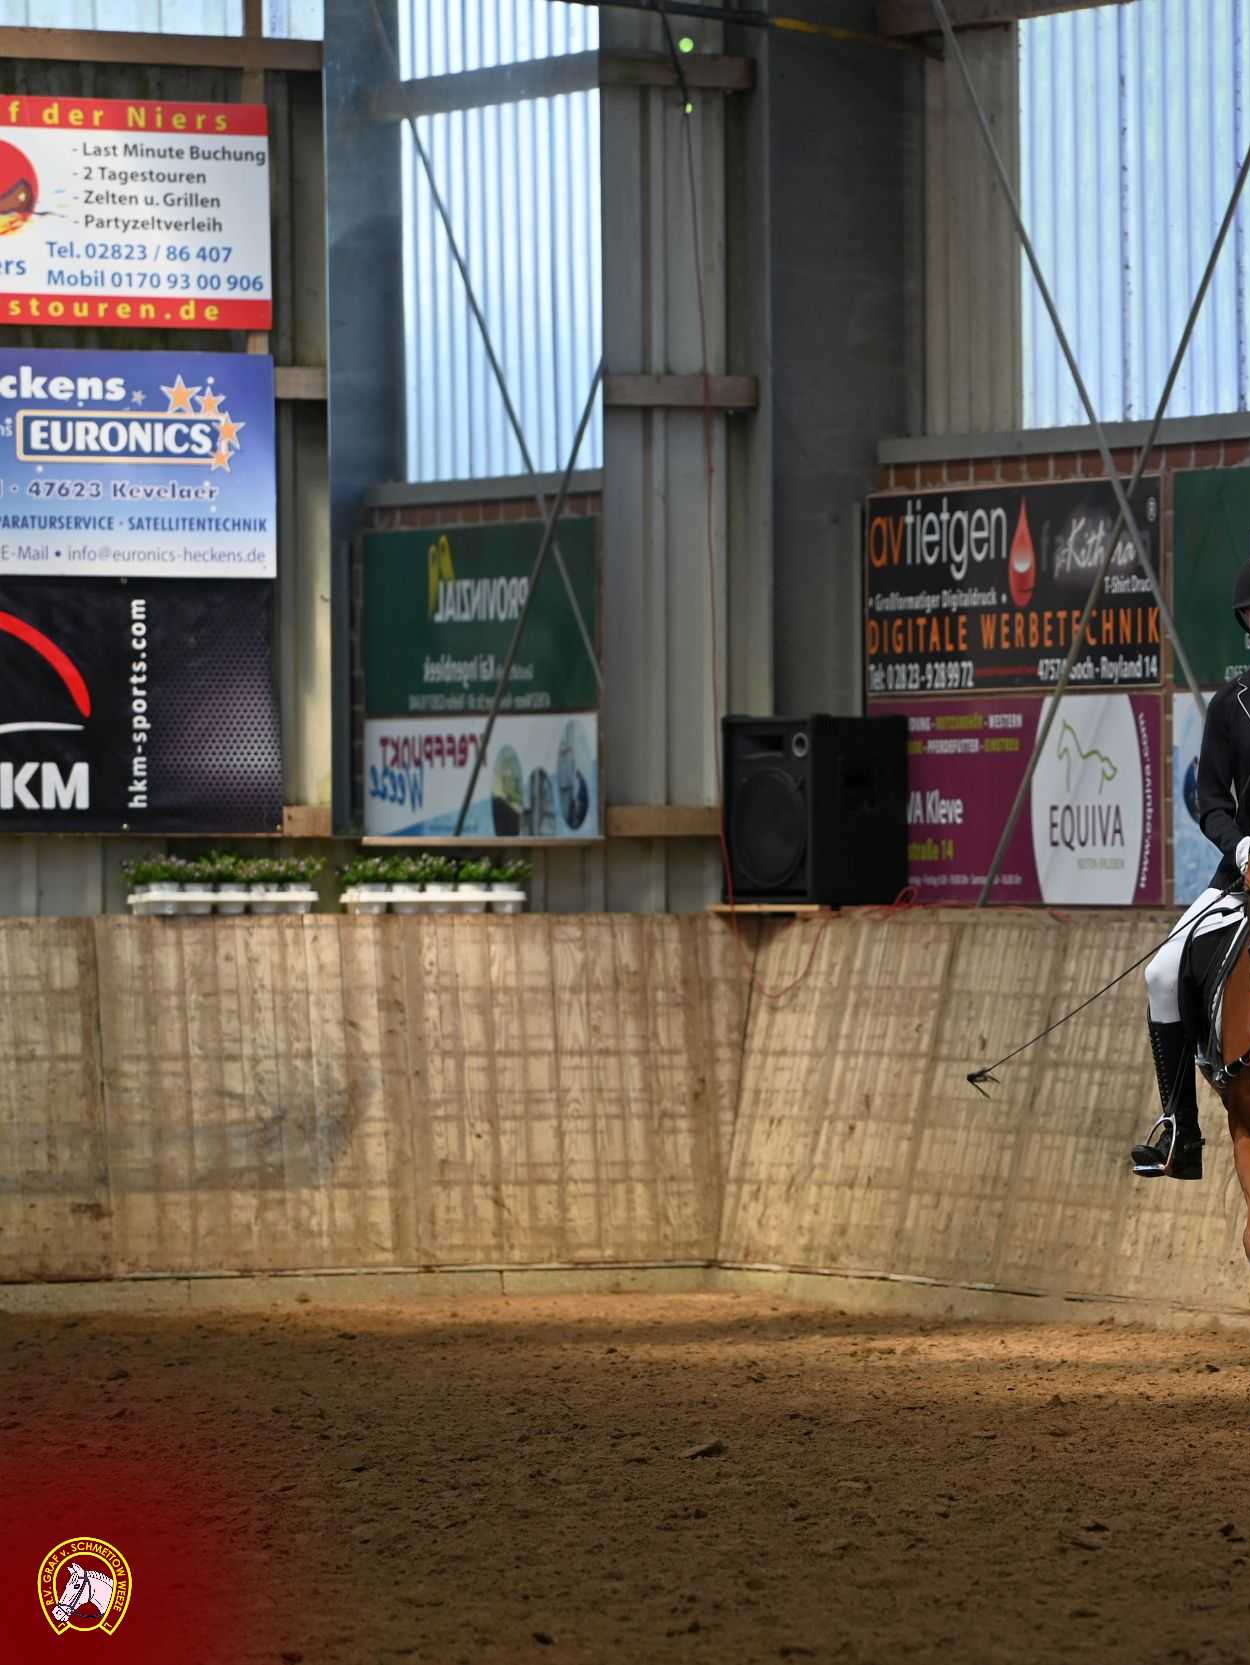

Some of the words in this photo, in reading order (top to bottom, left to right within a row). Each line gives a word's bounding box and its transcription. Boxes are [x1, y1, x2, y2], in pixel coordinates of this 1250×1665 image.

[43, 103, 103, 126] der
[128, 107, 228, 130] Niers
[83, 143, 117, 158] Last
[124, 143, 185, 160] Minute
[190, 146, 266, 165] Buchung
[84, 167, 93, 180] 2
[99, 167, 206, 185] Tagestouren
[84, 191, 138, 206] Zelten
[144, 195, 160, 207] u.
[163, 192, 221, 208] Grillen
[84, 215, 223, 232] Partyzeltverleih
[46, 242, 80, 259] Tel.
[85, 243, 148, 261] 02823
[166, 246, 190, 262] 86
[196, 246, 232, 263] 407
[47, 270, 105, 287] Mobil
[111, 272, 161, 289] 0170
[167, 273, 190, 289] 93
[197, 274, 221, 290] 00
[227, 275, 264, 291] 906
[9, 298, 219, 321] stouren.de
[30, 420, 212, 454] EURONICS
[28, 481, 102, 498] 47623
[112, 483, 218, 500] Kevelaer
[0, 516, 114, 531] ARATURSERVICE
[128, 516, 267, 532] SATELLITENTECHNIK
[1, 544, 49, 561] E-Mail
[68, 545, 265, 563] info@euronics-heckens.de
[868, 613, 968, 656] DIGITALE
[980, 607, 1160, 649] WERBETECHNIK
[1144, 654, 1158, 678] 14
[128, 598, 151, 808] hkm-sports.com
[927, 789, 964, 825] Kleve
[1050, 804, 1124, 851] EQUIVA
